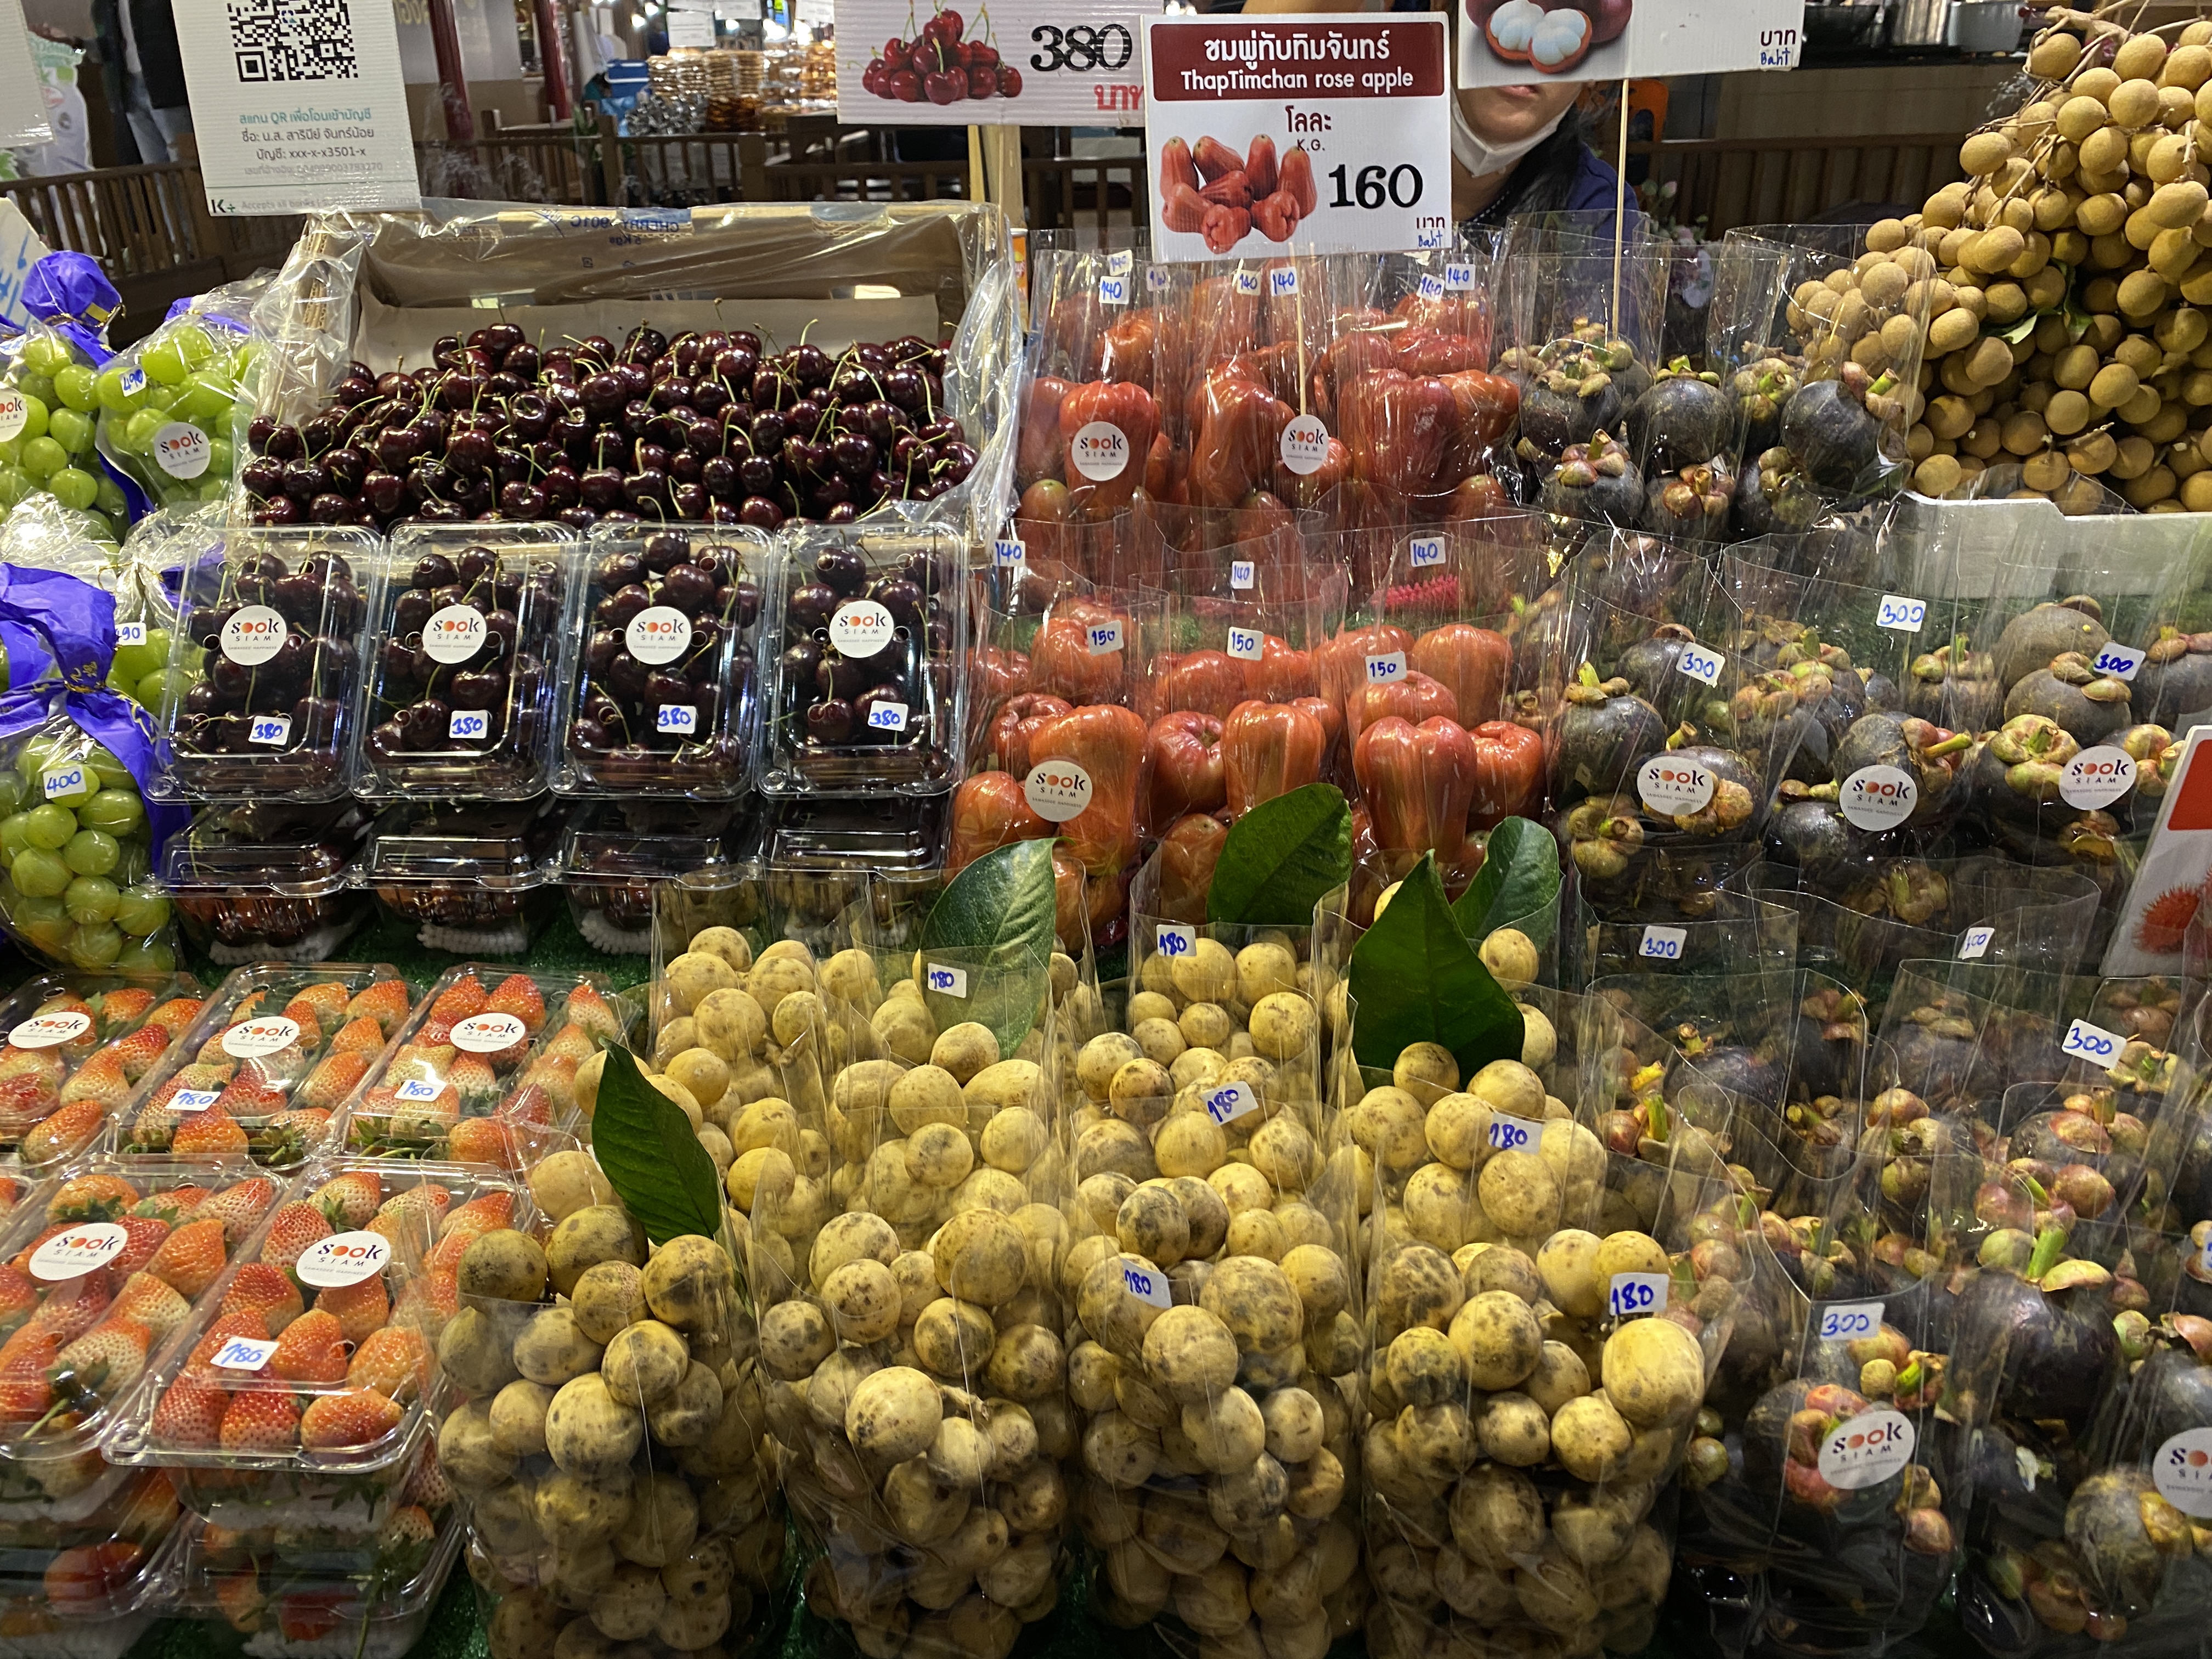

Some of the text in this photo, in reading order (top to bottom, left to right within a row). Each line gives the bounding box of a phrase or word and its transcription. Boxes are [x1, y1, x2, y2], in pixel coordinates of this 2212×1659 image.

[1760, 29, 1796, 46] บาท
[1030, 24, 1132, 71] 380
[1204, 30, 1390, 70] ชมพู่ทับทิมจันทร์
[1760, 48, 1791, 66] Baht
[1181, 67, 1413, 97] ThapTimchan rose apple
[270, 112, 287, 124] QR
[1285, 105, 1332, 132] โลละ
[256, 146, 366, 161] บัญชี: xxx-x-x3501-x
[1297, 139, 1325, 151] K.G.
[1328, 163, 1423, 208] 160
[1240, 273, 1257, 290] 140
[1273, 272, 1295, 295] 140
[1448, 267, 1469, 285] 140
[1101, 280, 1122, 300] 140
[0, 397, 22, 413] ook
[170, 448, 199, 459] SIAM
[995, 541, 1022, 566] 140
[1413, 542, 1437, 565] 140
[1234, 565, 1250, 582] 140
[1880, 603, 1923, 625] 300
[116, 627, 140, 640] 90
[1091, 630, 1115, 646] 150
[1232, 631, 1254, 651] 150
[1369, 662, 1396, 678] 150
[1682, 652, 1715, 678] 300
[2094, 653, 2133, 673] 300
[452, 717, 482, 735] 380
[657, 707, 691, 726] 380
[869, 710, 900, 726] 380
[252, 723, 283, 739] 380
[47, 771, 81, 792] 400
[1654, 782, 1695, 794] SIAM
[1040, 787, 1076, 798] SIAM
[1857, 794, 1898, 806] SIAM
[1159, 932, 1187, 956] 180
[930, 971, 954, 990] 180
[2063, 1027, 2113, 1055] 300
[1207, 1088, 1239, 1122] 180
[1489, 1122, 1528, 1149] 180
[53, 1249, 98, 1257] SIAM
[318, 1257, 364, 1266] SIAM
[1125, 1269, 1151, 1295] 180
[1612, 1282, 1654, 1316] 180
[1821, 1313, 1870, 1337] 300
[1841, 1444, 1891, 1462] SIAM
